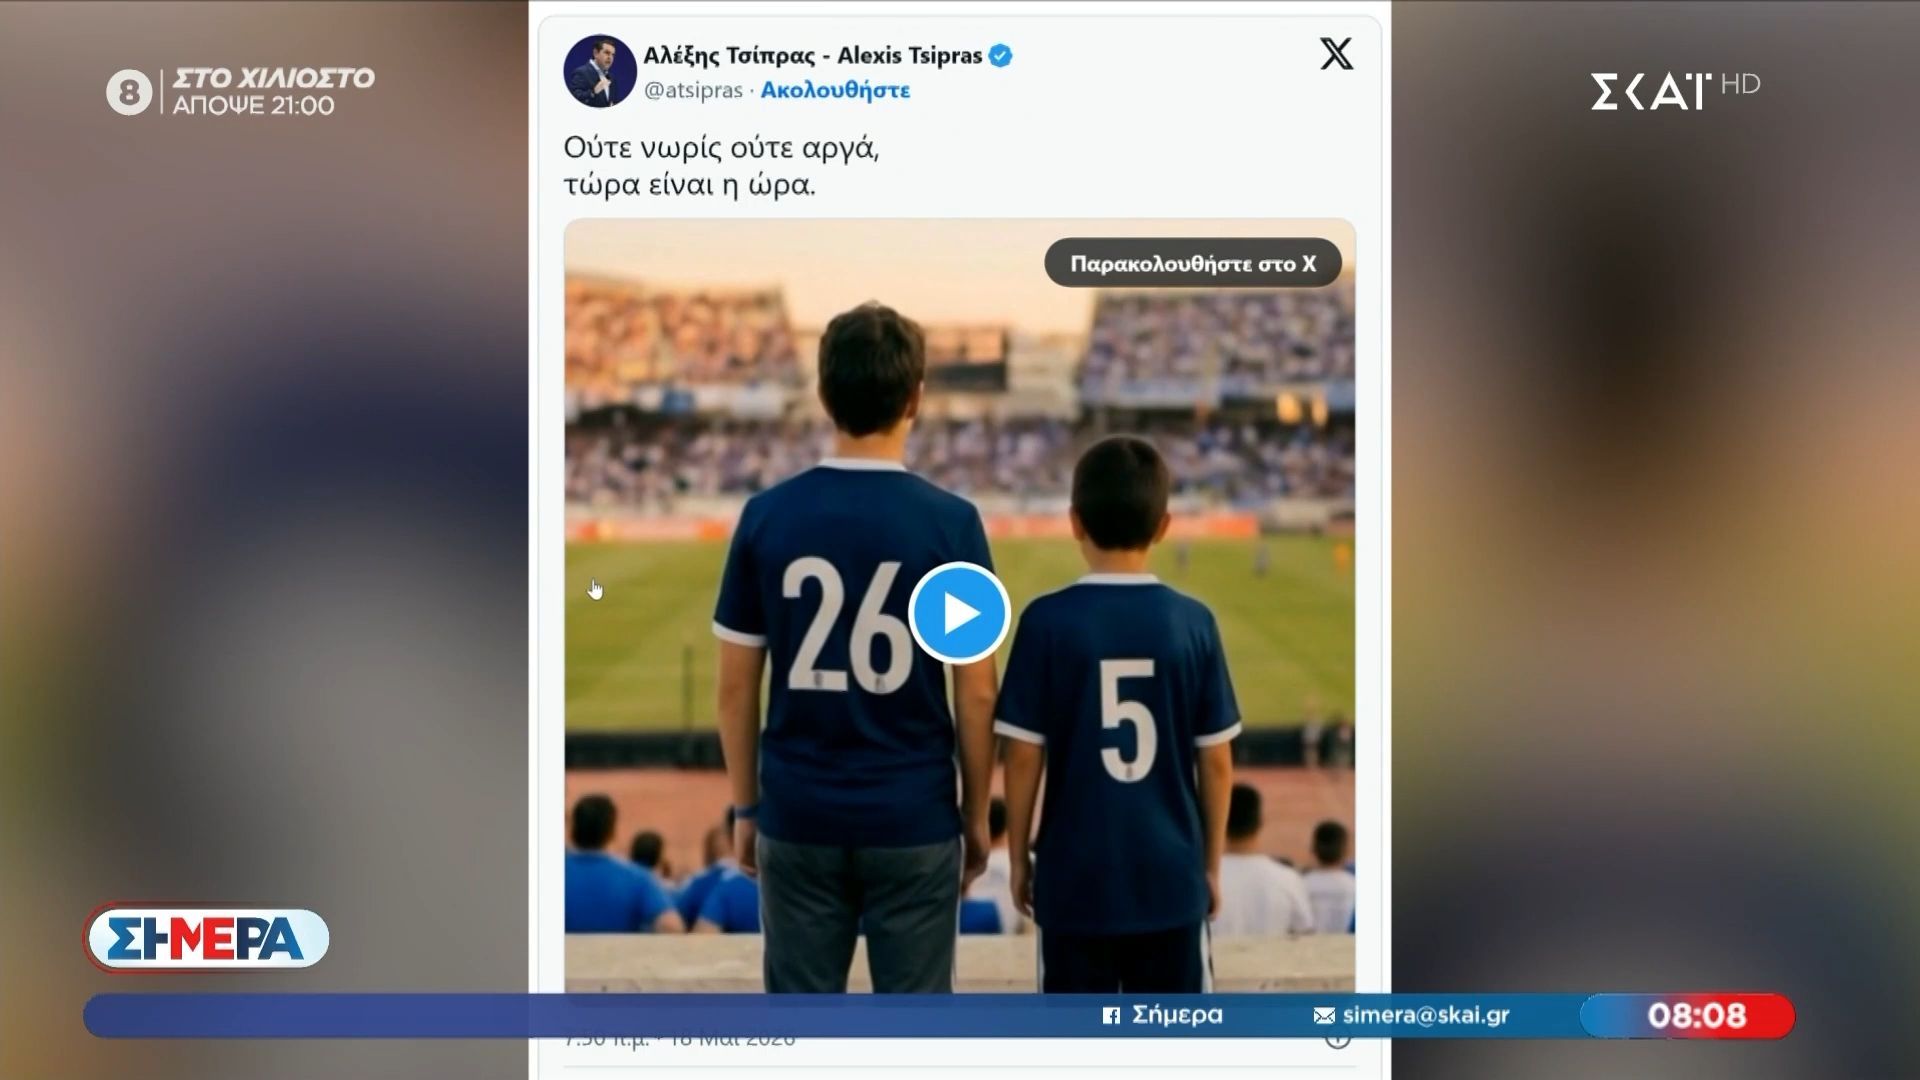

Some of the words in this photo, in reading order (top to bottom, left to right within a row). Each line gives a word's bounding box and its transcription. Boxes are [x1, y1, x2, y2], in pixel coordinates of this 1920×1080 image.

[643, 45, 720, 70] Αλέξης
[726, 45, 815, 70] Τσίπρας
[837, 45, 902, 64] Alexis
[908, 45, 984, 70] Tsipras
[645, 80, 743, 104] @atsipras
[760, 79, 911, 104] Ακολουθήστε
[564, 133, 632, 158] Ούτε
[641, 133, 722, 164] νωρίς
[731, 133, 793, 158] ούτε
[803, 133, 880, 165] αργά,
[563, 171, 640, 202] τώρα
[649, 171, 713, 196] είναι
[723, 178, 738, 202] η
[749, 171, 815, 202] ώρα.
[1071, 254, 1252, 277] Παρακολουθήστε
[1258, 258, 1296, 273] στο
[782, 555, 914, 695] 26
[1100, 659, 1157, 783] 5
